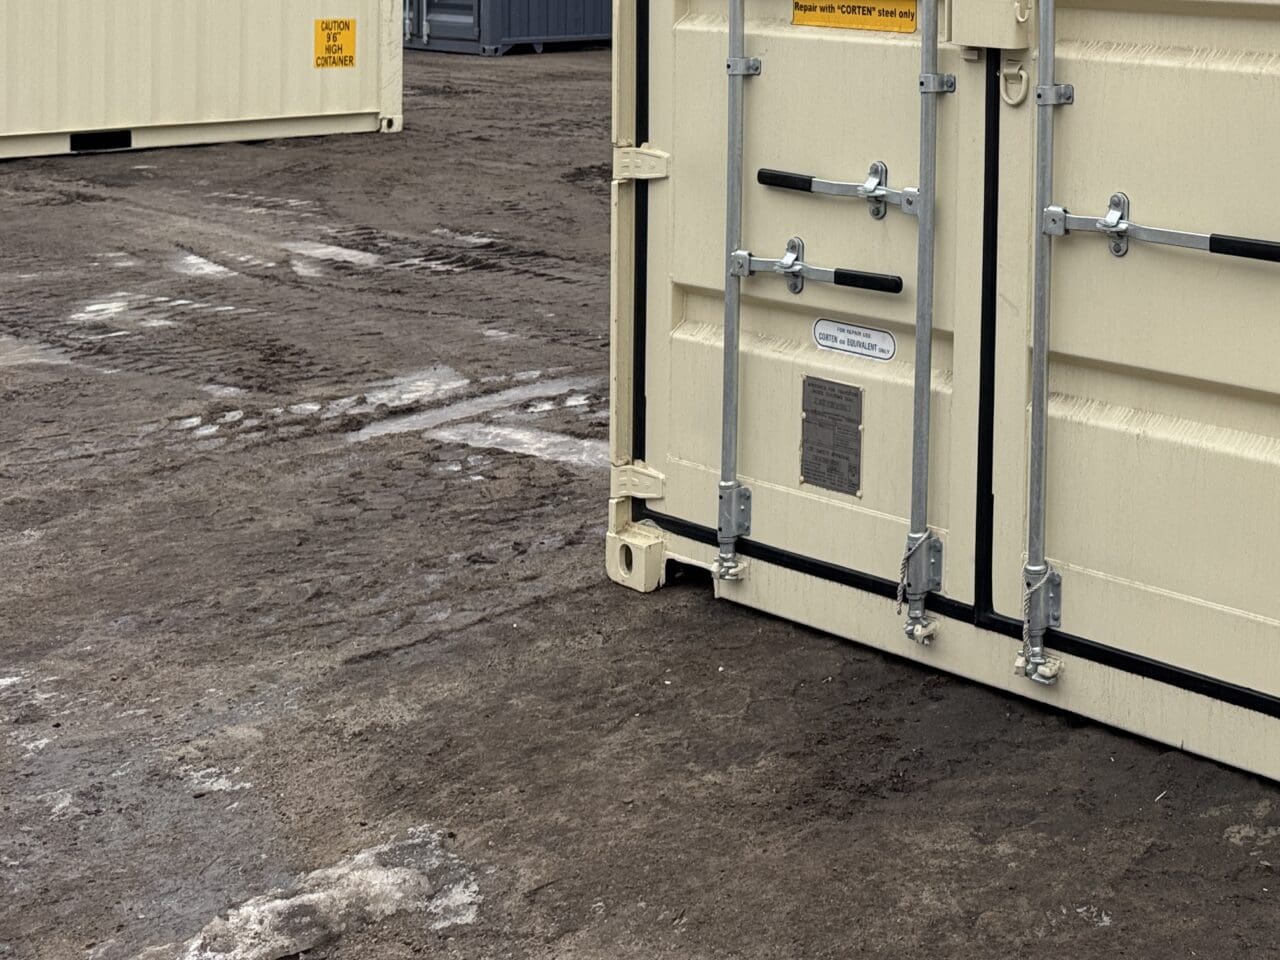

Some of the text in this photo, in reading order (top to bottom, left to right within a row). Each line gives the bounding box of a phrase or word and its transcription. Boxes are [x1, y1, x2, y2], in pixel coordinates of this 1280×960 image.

[794, 2, 817, 14] Repair
[819, 4, 835, 13] with
[878, 8, 896, 17] steel
[899, 9, 915, 21] only
[321, 20, 350, 31] CAUTION
[325, 44, 342, 54] HIGH
[316, 55, 354, 67] CONTAINER
[819, 332, 838, 343] CORTEN
[847, 338, 877, 352] EQUIVALENT
